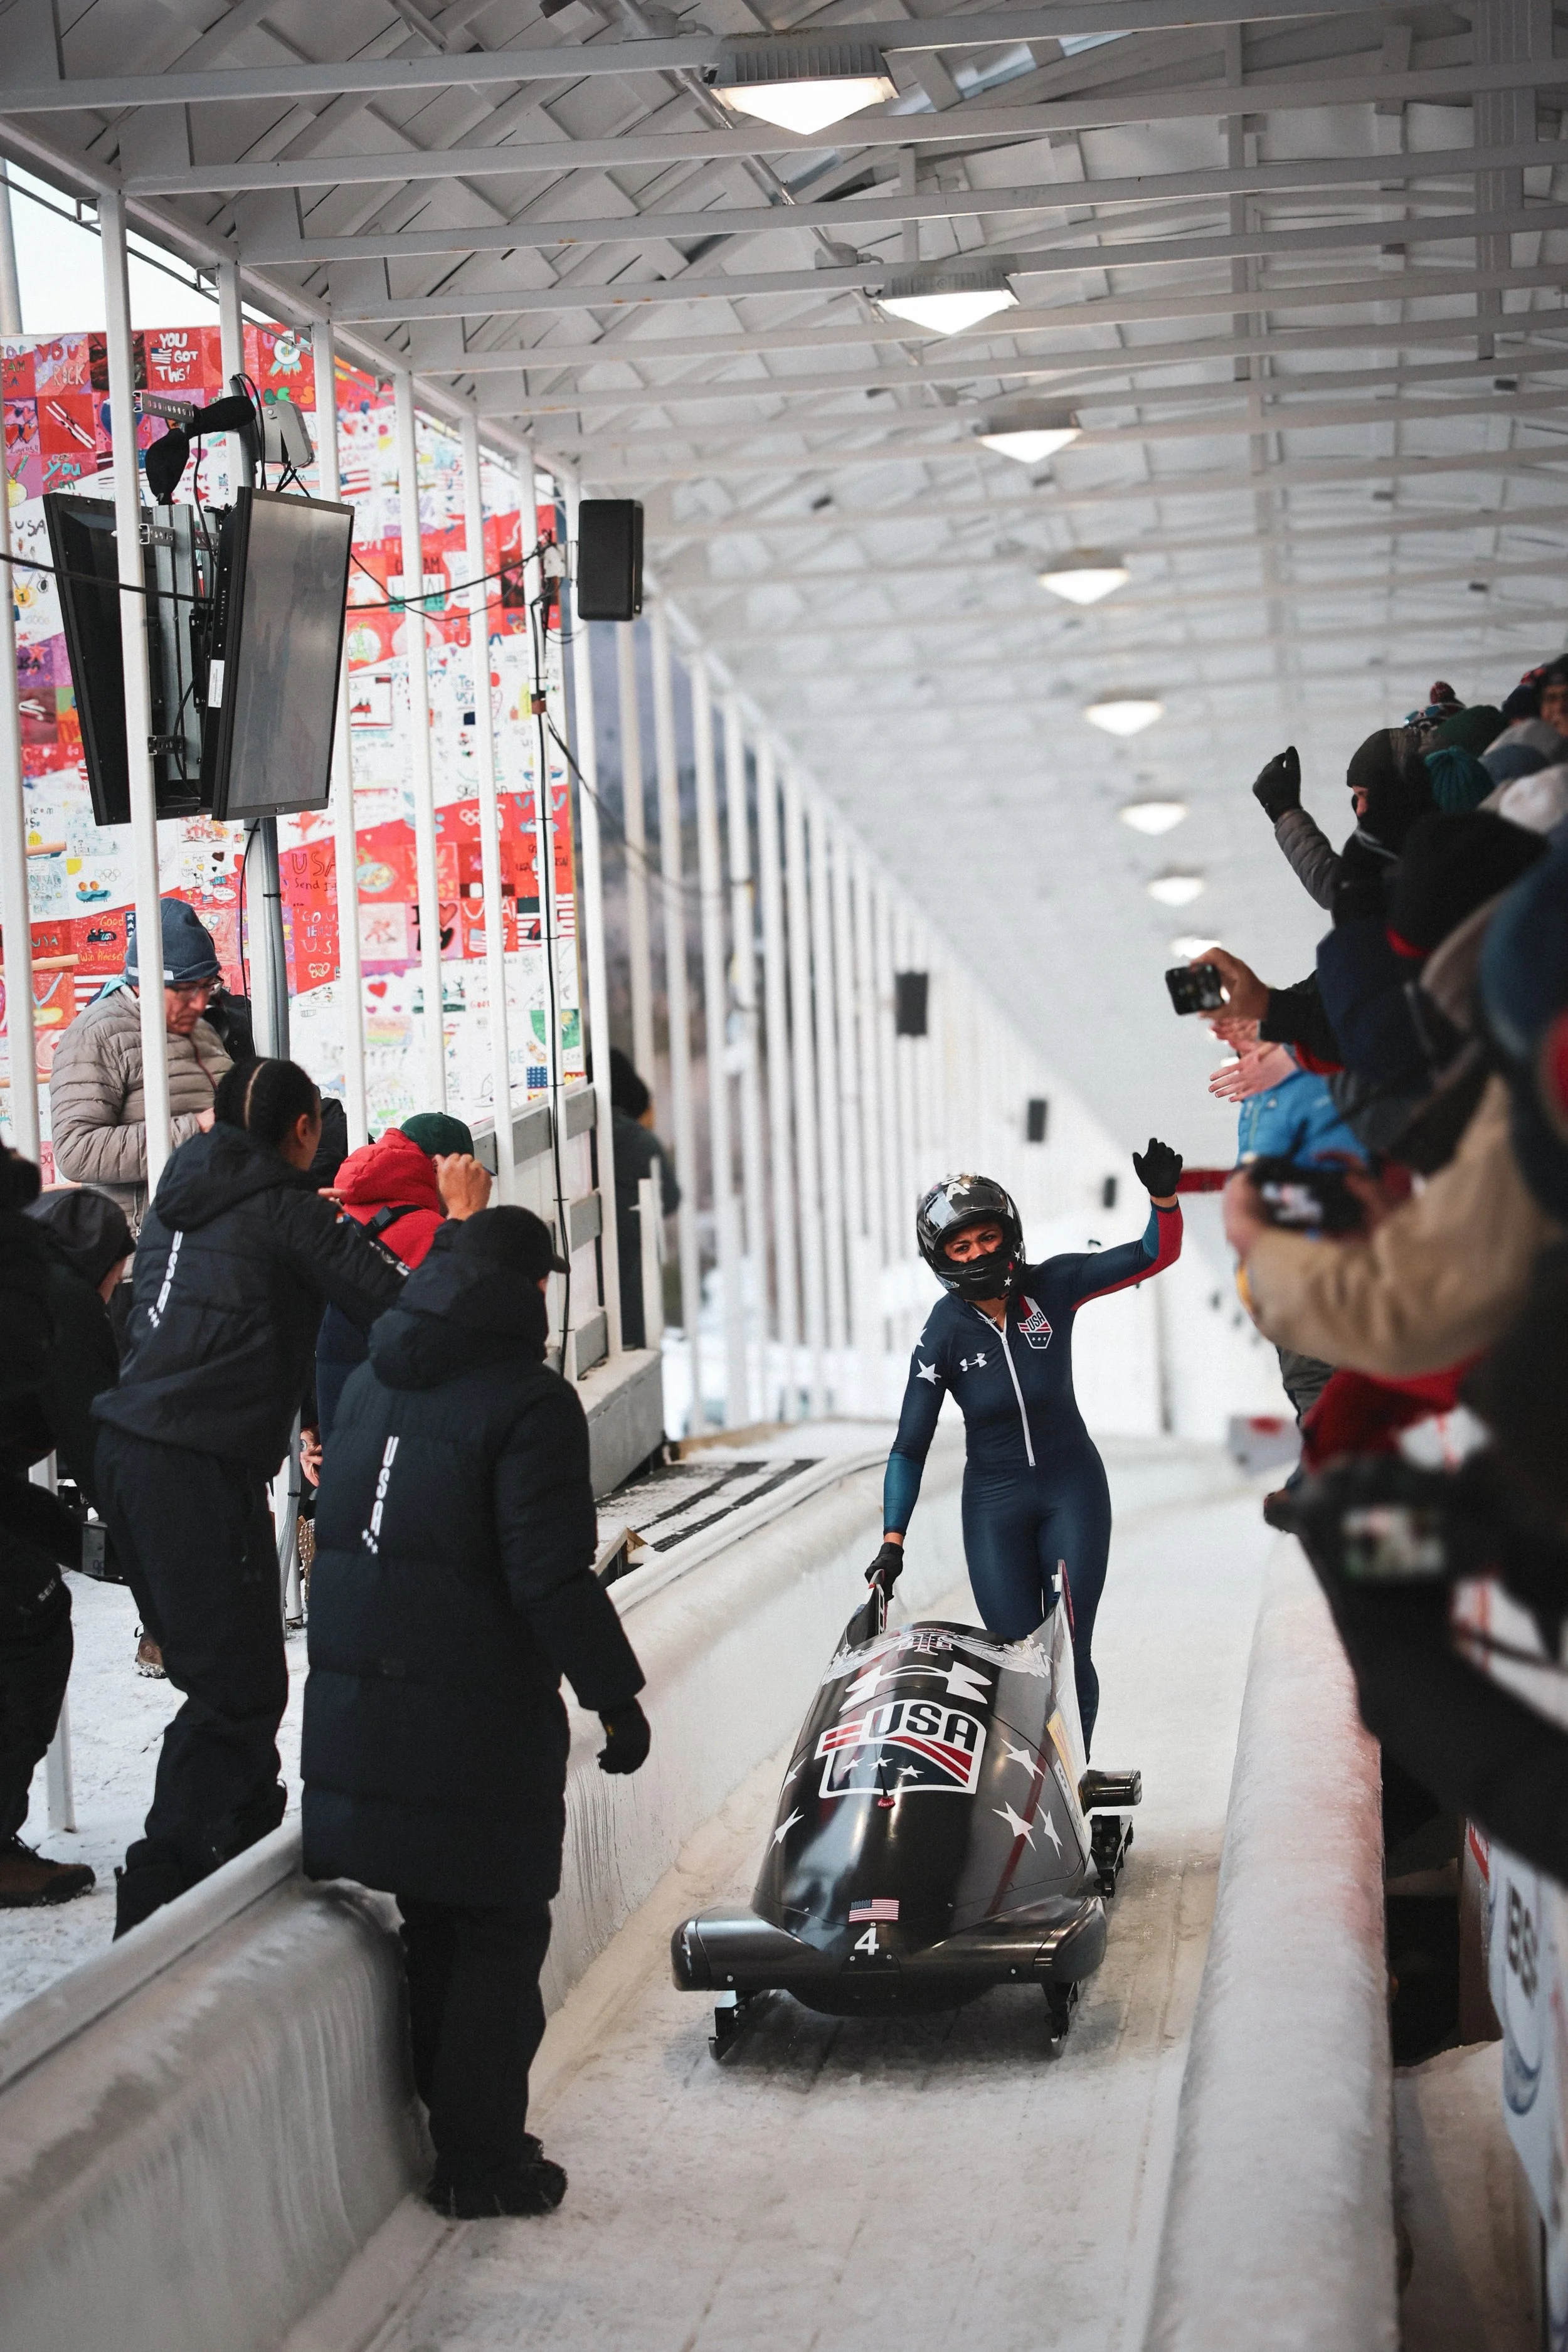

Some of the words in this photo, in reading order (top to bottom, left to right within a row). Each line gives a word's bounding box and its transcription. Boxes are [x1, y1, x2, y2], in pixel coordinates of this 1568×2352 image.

[159, 332, 188, 349] YOU
[36, 342, 79, 362] YOU
[174, 349, 199, 363] GOT
[15, 519, 46, 537] USA
[295, 877, 320, 889] Send
[100, 913, 125, 927] Good
[80, 953, 95, 962] Win
[156, 1230, 184, 1314] USA
[1026, 1311, 1046, 1331] USA
[369, 1435, 400, 1537] USA
[868, 1703, 978, 1753] USA
[854, 1927, 880, 1956] 4
